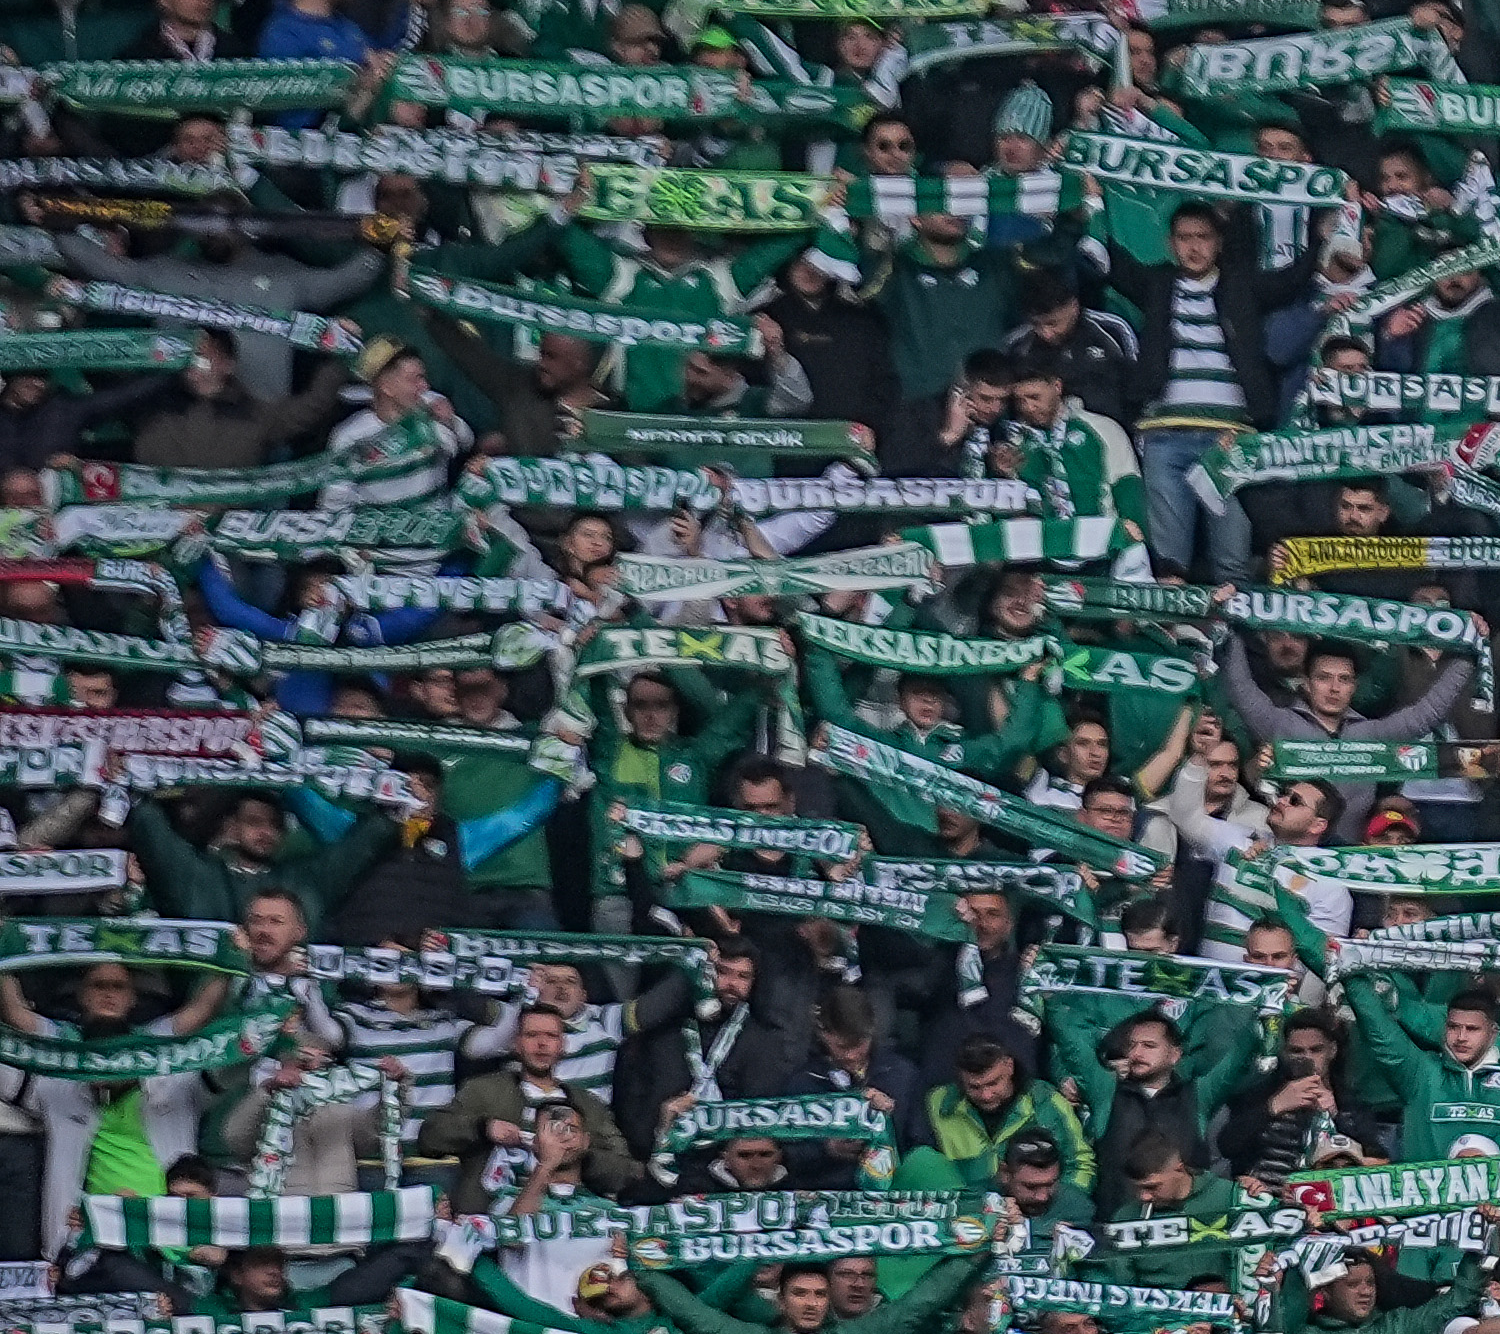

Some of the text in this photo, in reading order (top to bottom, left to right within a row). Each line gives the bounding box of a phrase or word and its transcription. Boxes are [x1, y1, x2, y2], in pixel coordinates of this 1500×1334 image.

[447, 67, 689, 111] BURSASPOR
[610, 627, 790, 667] TEXAS
[23, 924, 219, 955] TEXAS
[1450, 1106, 1497, 1121] TEXAS
[1341, 1159, 1493, 1215] ANLAYAN
[682, 1222, 940, 1263] BURSASPOR
[1109, 1207, 1307, 1249] TEXAS
